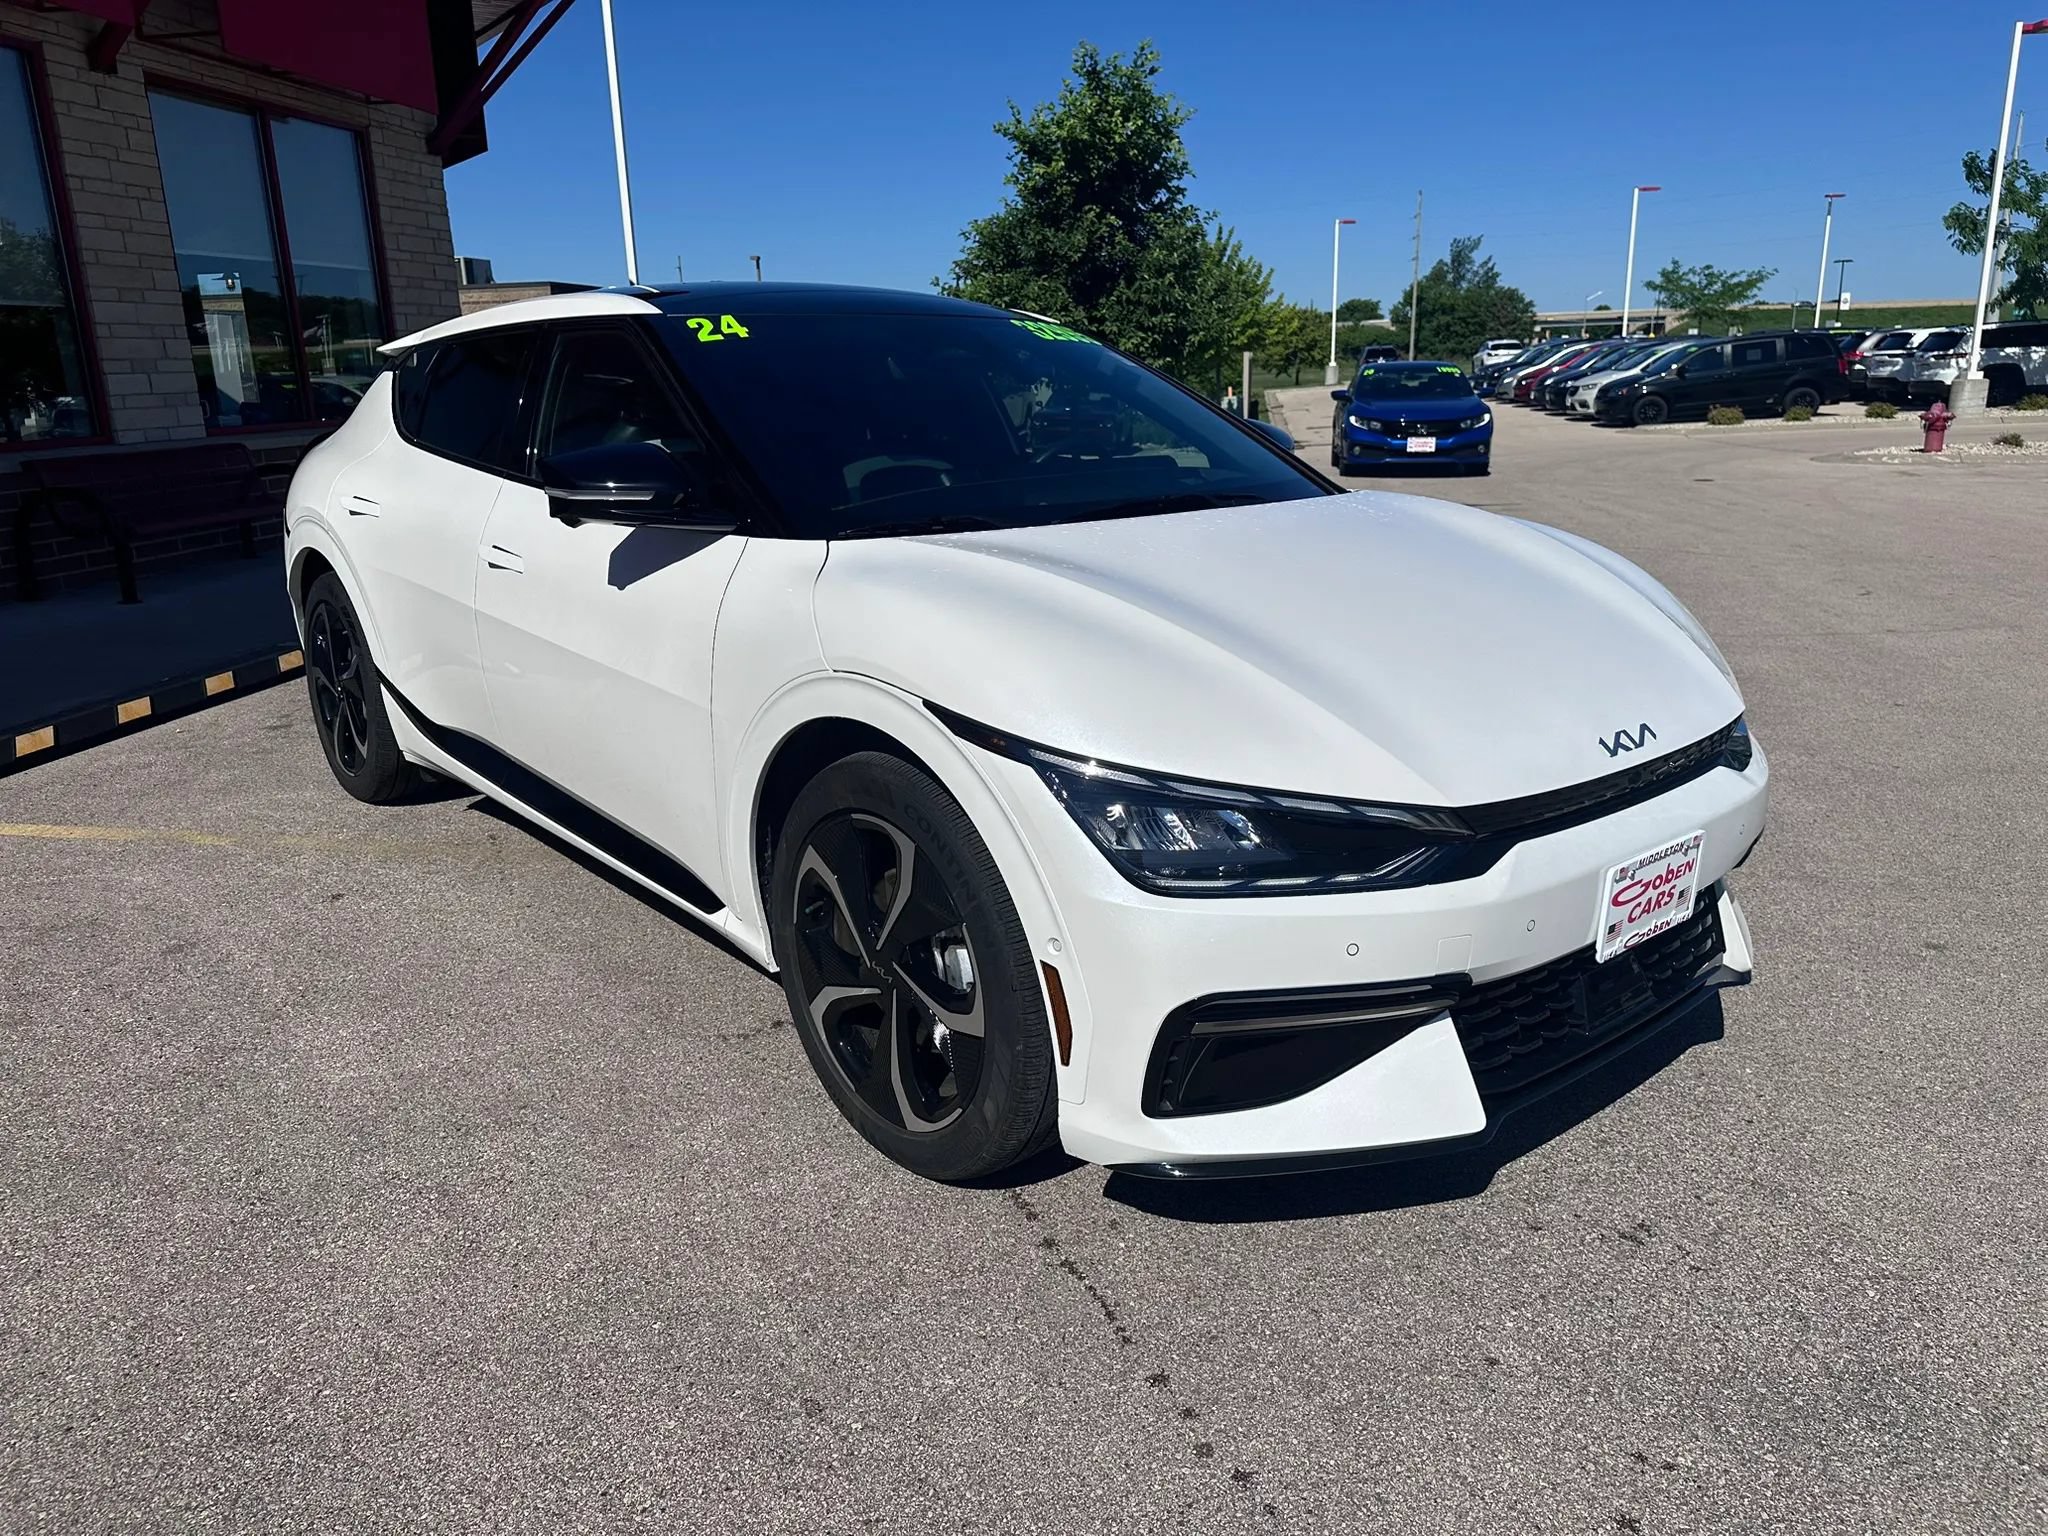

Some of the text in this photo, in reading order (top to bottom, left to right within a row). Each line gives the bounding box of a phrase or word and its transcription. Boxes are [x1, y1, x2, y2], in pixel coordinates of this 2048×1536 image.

[686, 314, 749, 342] 24
[1599, 722, 1657, 758] KIA
[1636, 840, 1687, 869] MIDDLETON
[1626, 883, 1676, 924] CARS
